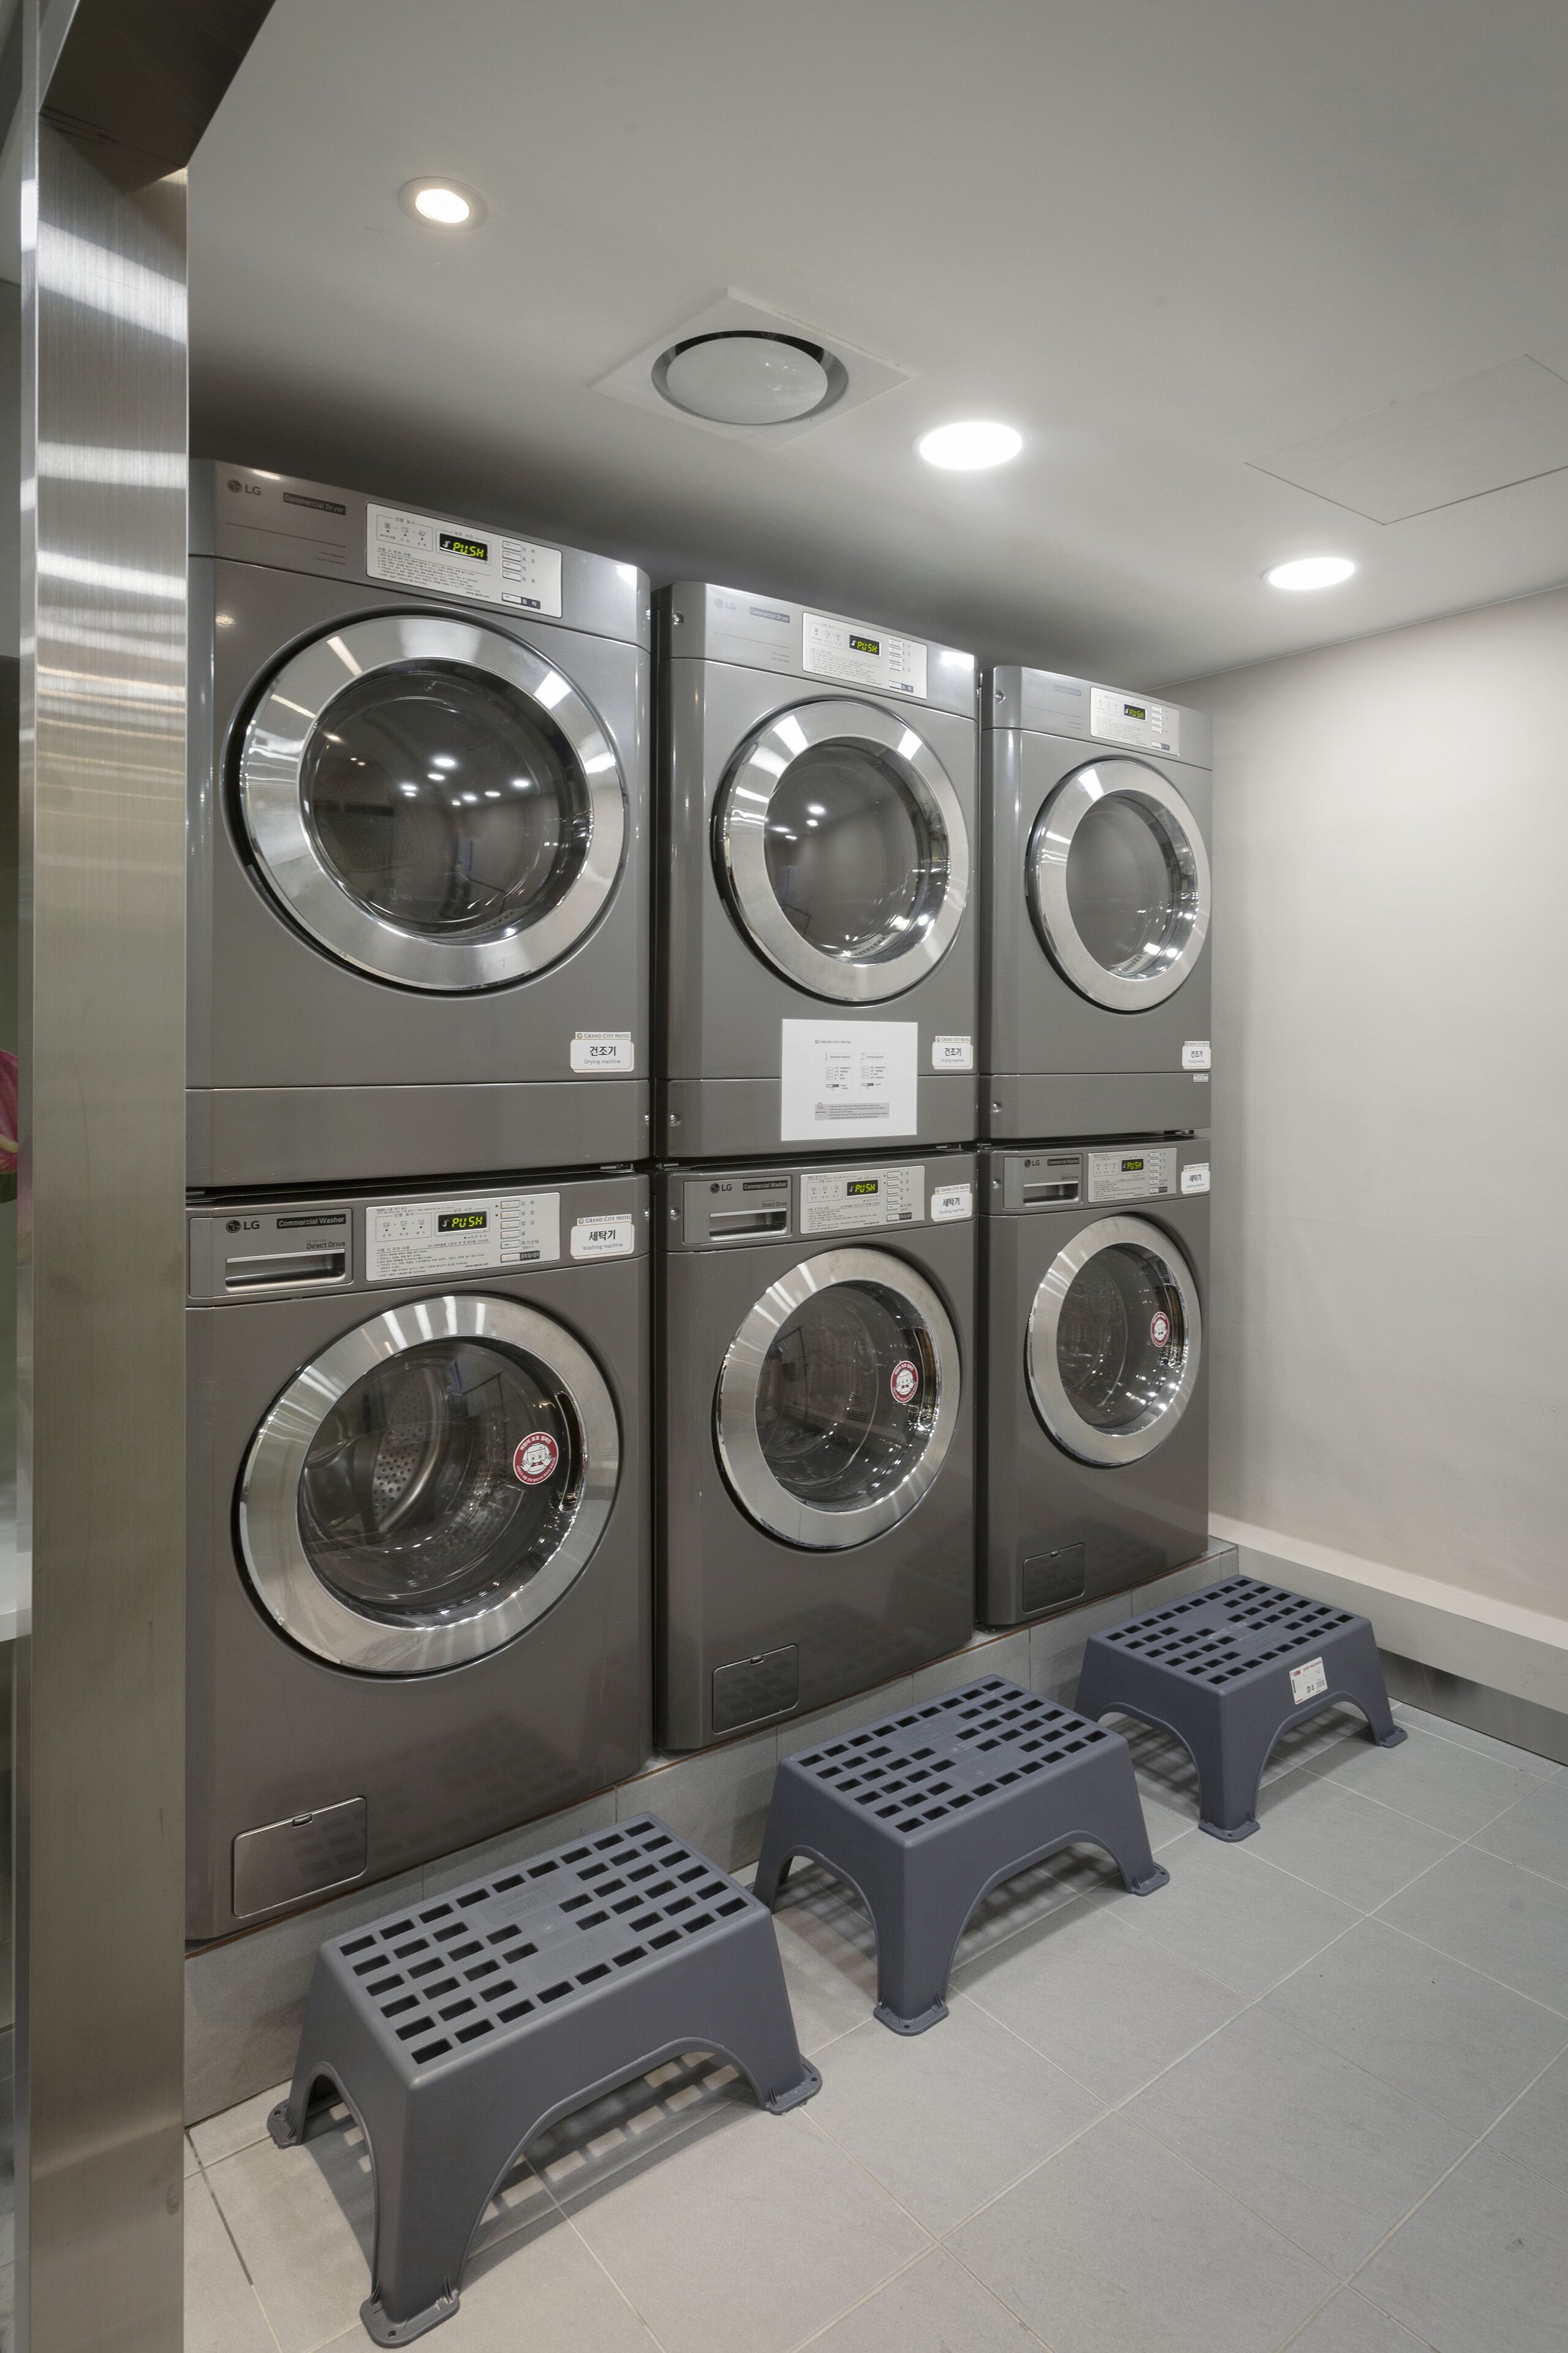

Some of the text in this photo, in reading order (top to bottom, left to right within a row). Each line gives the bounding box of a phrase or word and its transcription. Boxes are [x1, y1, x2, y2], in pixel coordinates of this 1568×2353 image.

[245, 484, 261, 496] LG
[284, 494, 344, 513] Commercial Dryer
[453, 542, 484, 558] PUSH
[725, 602, 736, 610] LG
[857, 641, 877, 653] PUSH
[589, 1046, 616, 1056] 건조기
[944, 1048, 961, 1056] 건조기
[855, 1183, 876, 1192] PUSH
[942, 1197, 960, 1207] 세탁기
[243, 1220, 260, 1230] LG
[278, 1215, 345, 1227] Commercial Washer
[452, 1216, 483, 1228] PUSH
[588, 1229, 616, 1241] 세탁기
